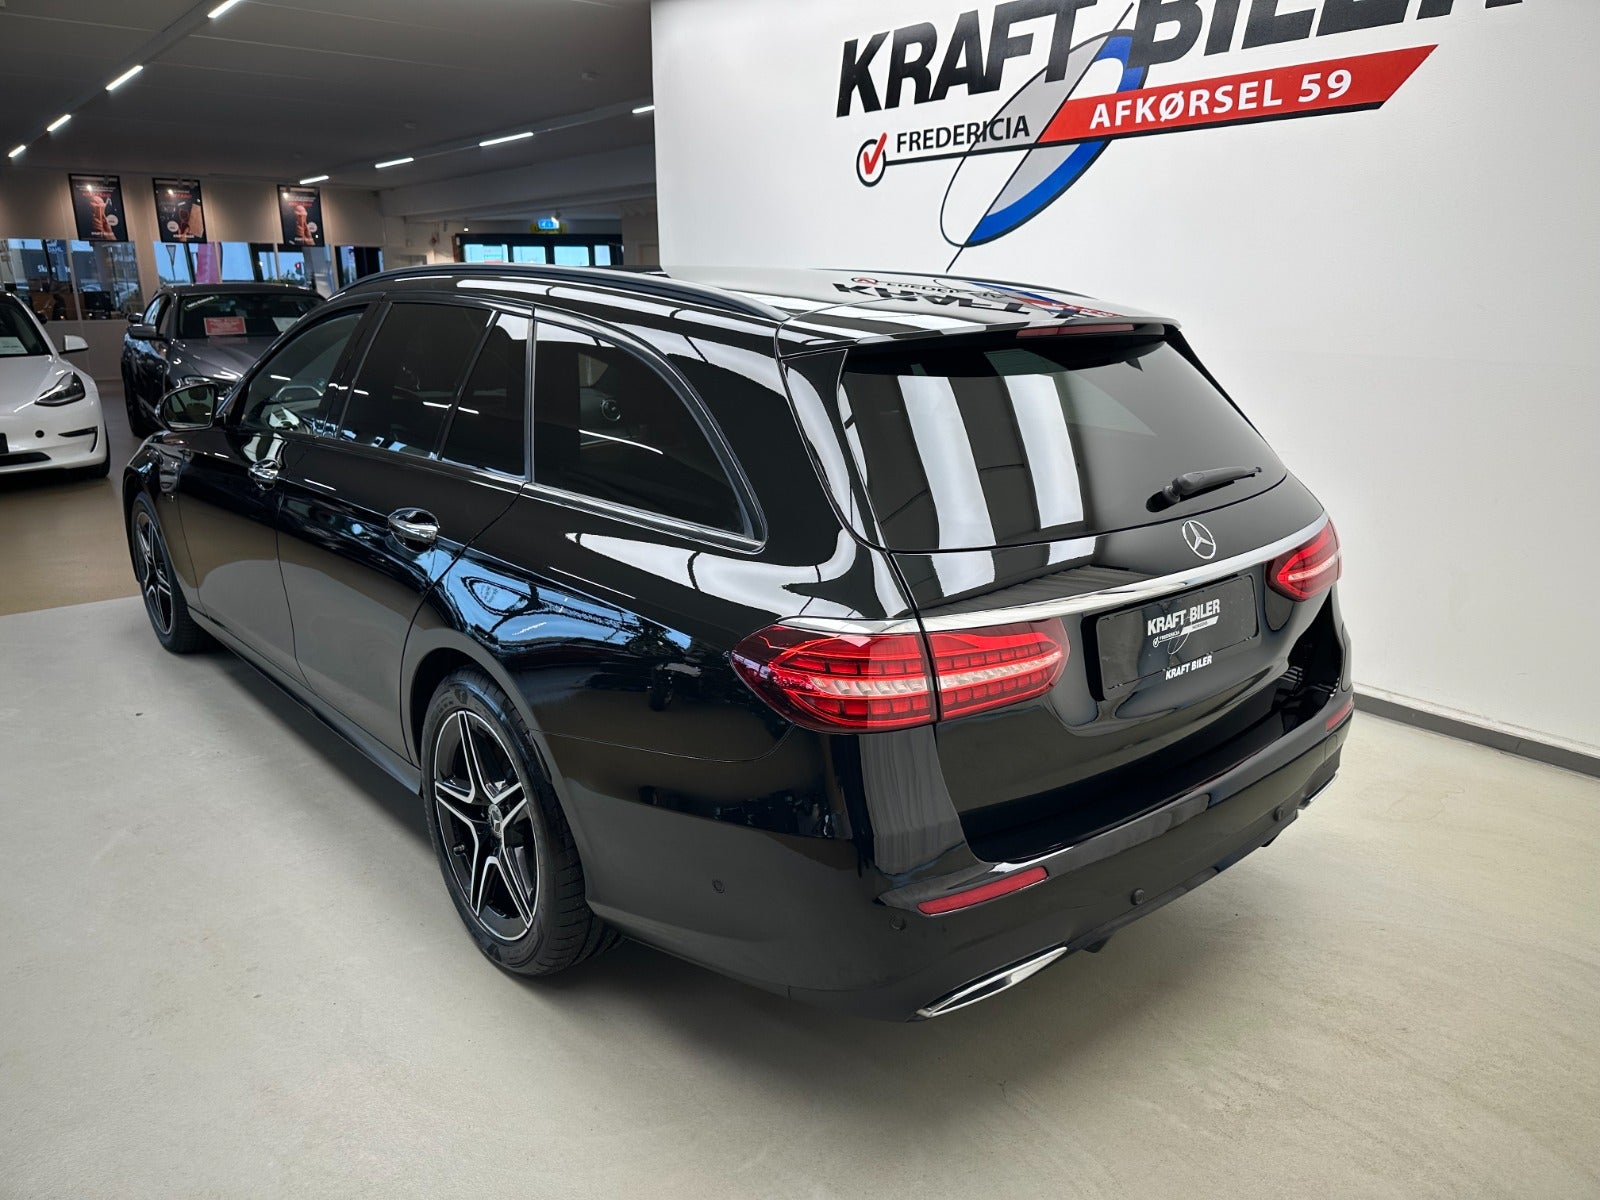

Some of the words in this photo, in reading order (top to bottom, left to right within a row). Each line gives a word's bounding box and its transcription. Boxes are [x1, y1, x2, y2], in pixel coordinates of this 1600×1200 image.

[836, 0, 1099, 118] KRAFT
[1126, 0, 1524, 69] BIL
[1089, 78, 1283, 130] AFKØRSEL
[1298, 69, 1352, 103] 59
[896, 115, 1030, 153] FREDERICIA
[1147, 609, 1187, 636] KRAFT
[1189, 598, 1220, 622] BILER
[1165, 663, 1190, 680] KRAFT
[1191, 655, 1212, 671] BILER
